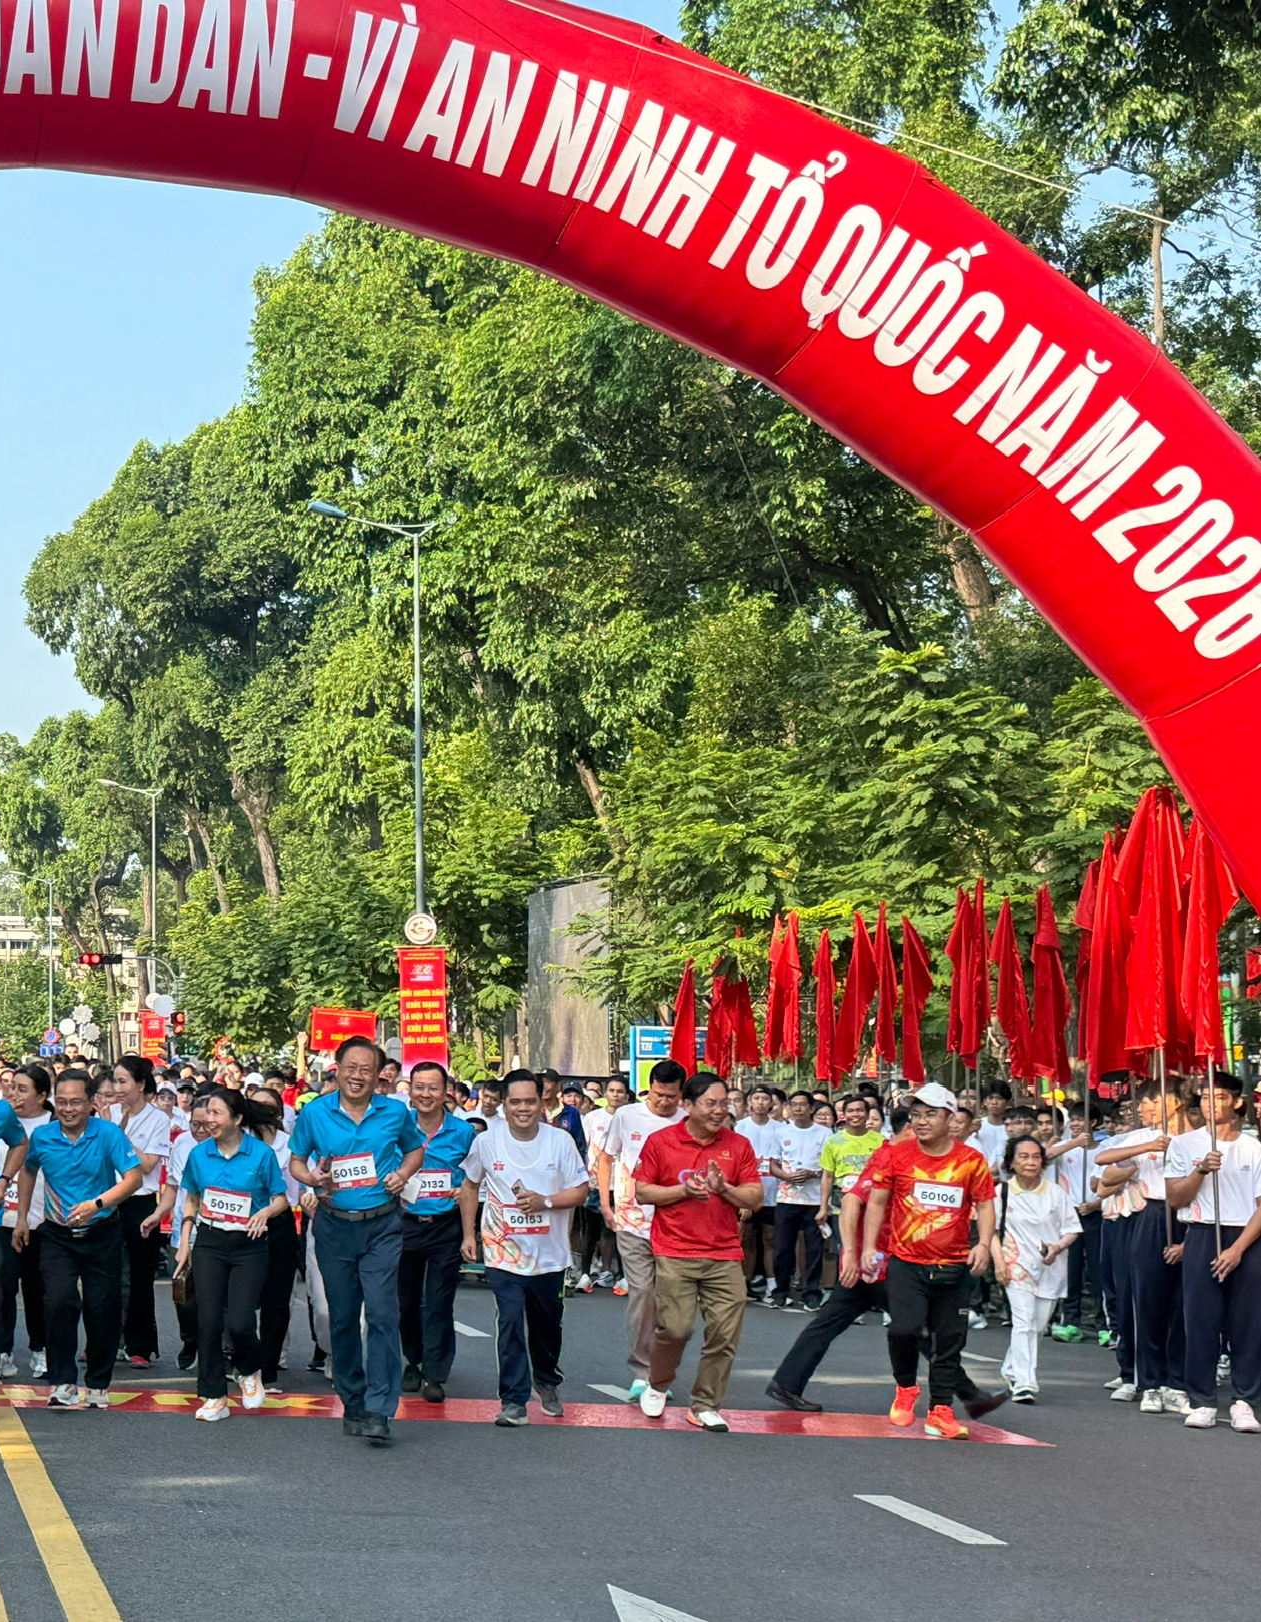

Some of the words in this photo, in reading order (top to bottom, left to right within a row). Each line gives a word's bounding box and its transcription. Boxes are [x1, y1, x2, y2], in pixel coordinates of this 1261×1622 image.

[334, 3, 419, 142] VÌ
[404, 39, 539, 178] AN
[521, 70, 736, 249] NINH
[709, 149, 848, 291] TỔ
[802, 204, 1006, 395] QUỐC
[952, 350, 1166, 523] NĂM
[316, 1030, 322, 1040] 3
[334, 1166, 368, 1179] 50158
[421, 1180, 445, 1189] 0132
[921, 1191, 956, 1204] 50106
[210, 1198, 243, 1213] 50157
[510, 1214, 543, 1225] 50153
